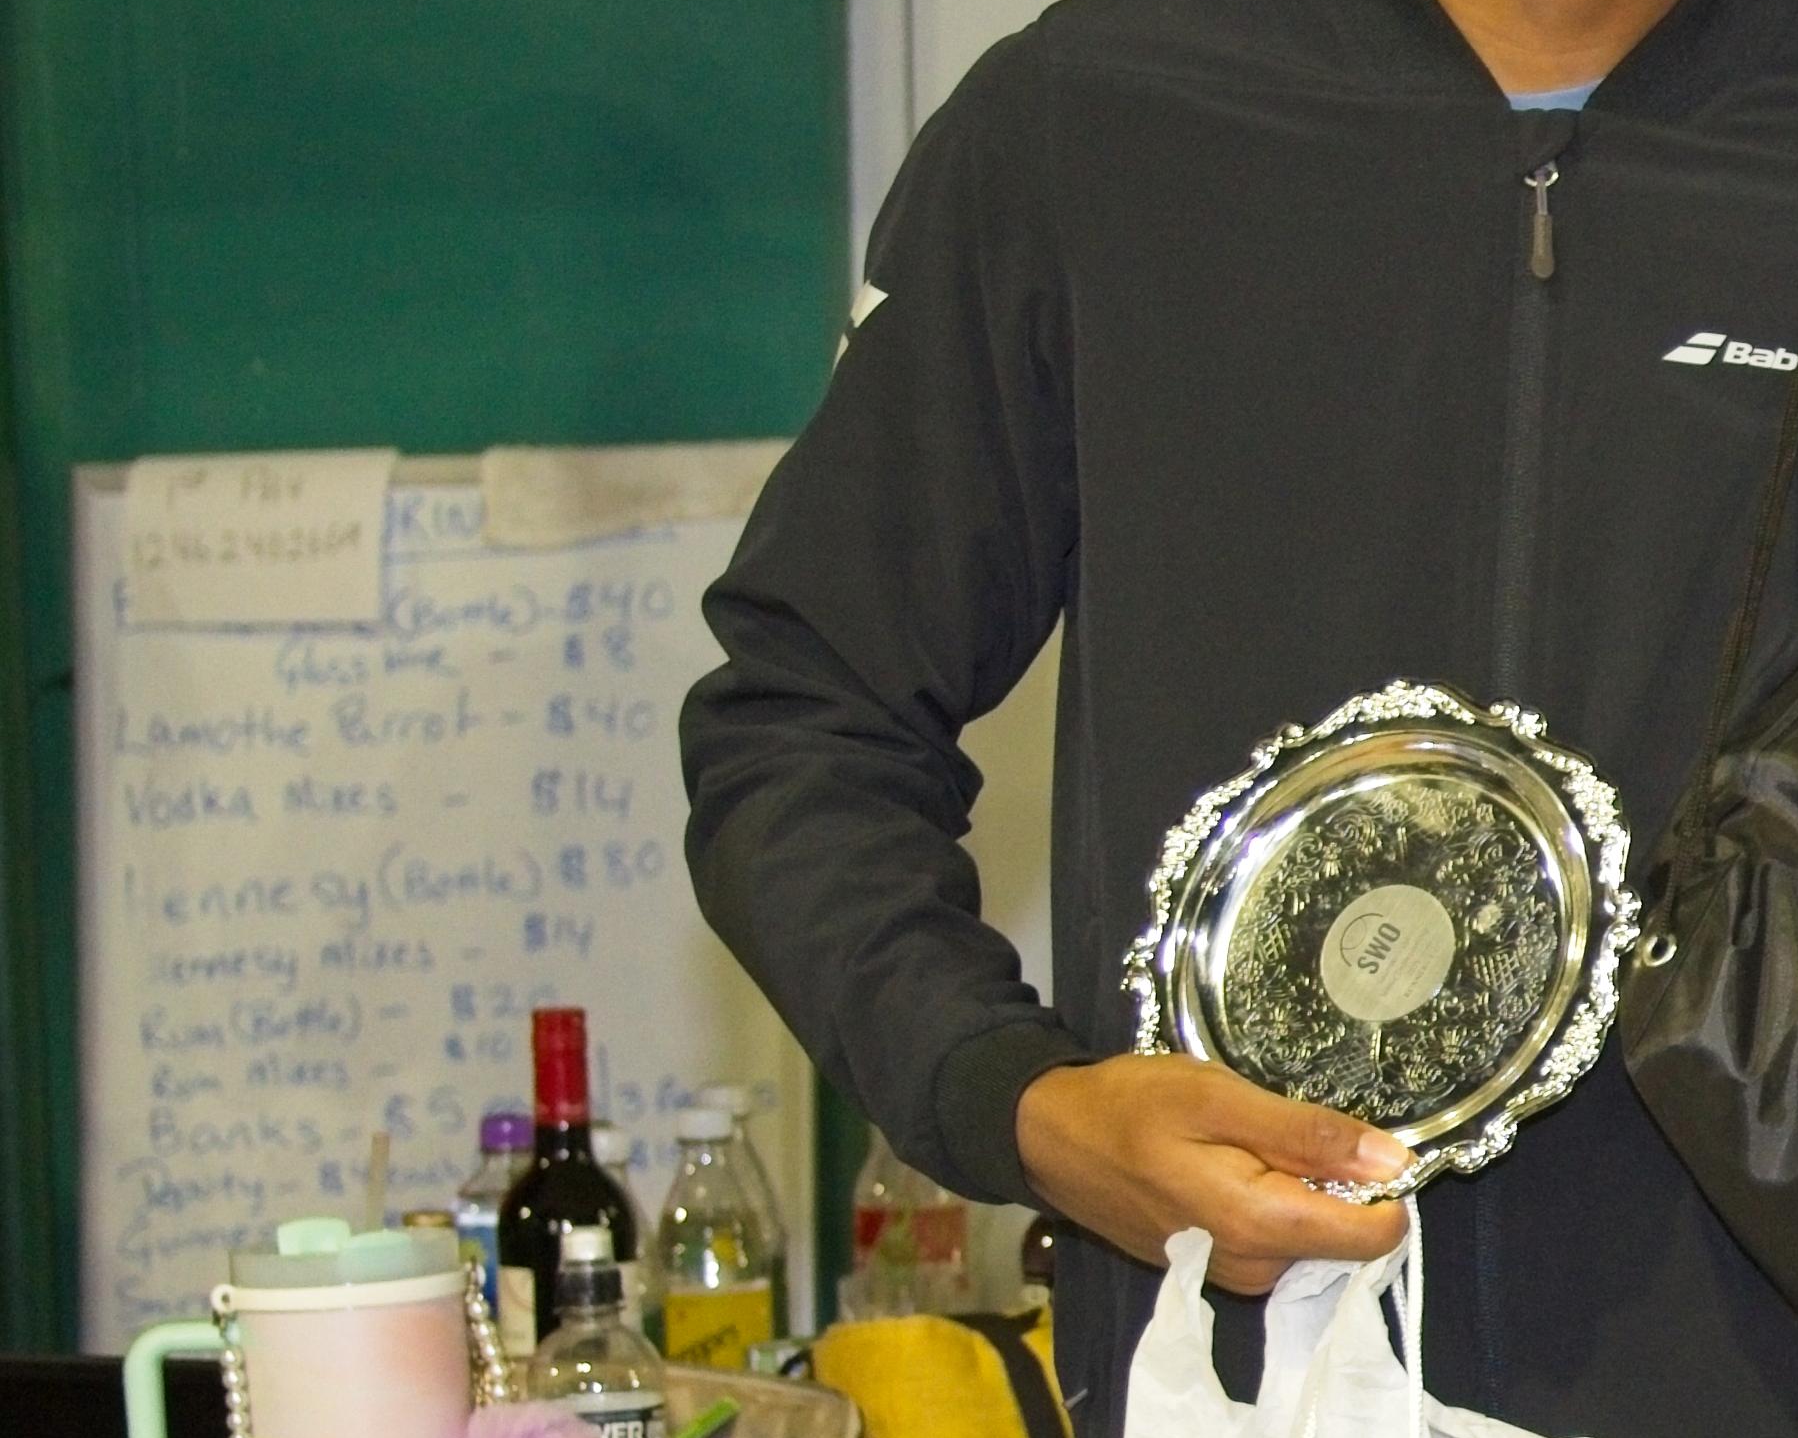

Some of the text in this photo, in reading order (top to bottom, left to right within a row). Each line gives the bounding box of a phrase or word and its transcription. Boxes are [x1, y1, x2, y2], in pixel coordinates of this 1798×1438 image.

[123, 772, 260, 828] Vodka
[1357, 922, 1401, 975] SWO
[149, 1105, 324, 1158] Banks
